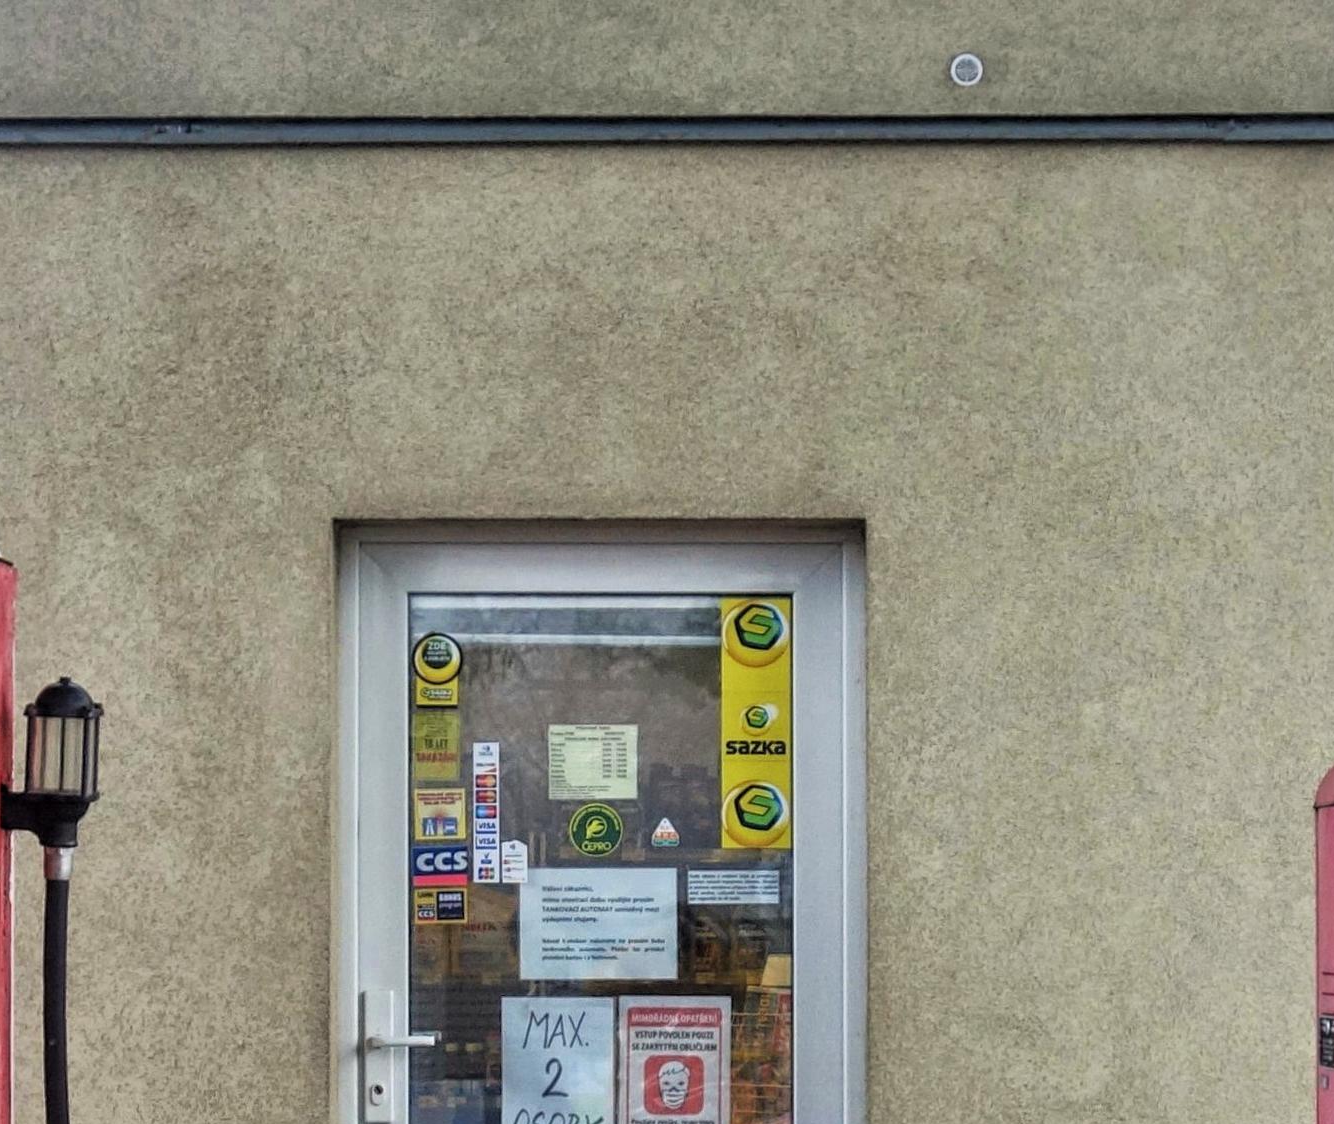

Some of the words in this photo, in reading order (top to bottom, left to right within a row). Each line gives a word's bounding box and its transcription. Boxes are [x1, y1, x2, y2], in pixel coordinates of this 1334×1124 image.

[427, 641, 447, 650] ZDE
[478, 821, 496, 830] VISA
[478, 837, 496, 845] VISA
[416, 851, 468, 872] CCS
[522, 1010, 590, 1050] MAX.
[634, 1030, 658, 1040] VSTUP
[658, 1030, 691, 1040] POVOLEN
[691, 1030, 715, 1040] POUZE
[631, 1042, 640, 1051] SE
[641, 1042, 678, 1051] ZAKRYTÝM
[679, 1041, 718, 1051] OBLIČEJEM
[541, 1057, 569, 1098] 2
